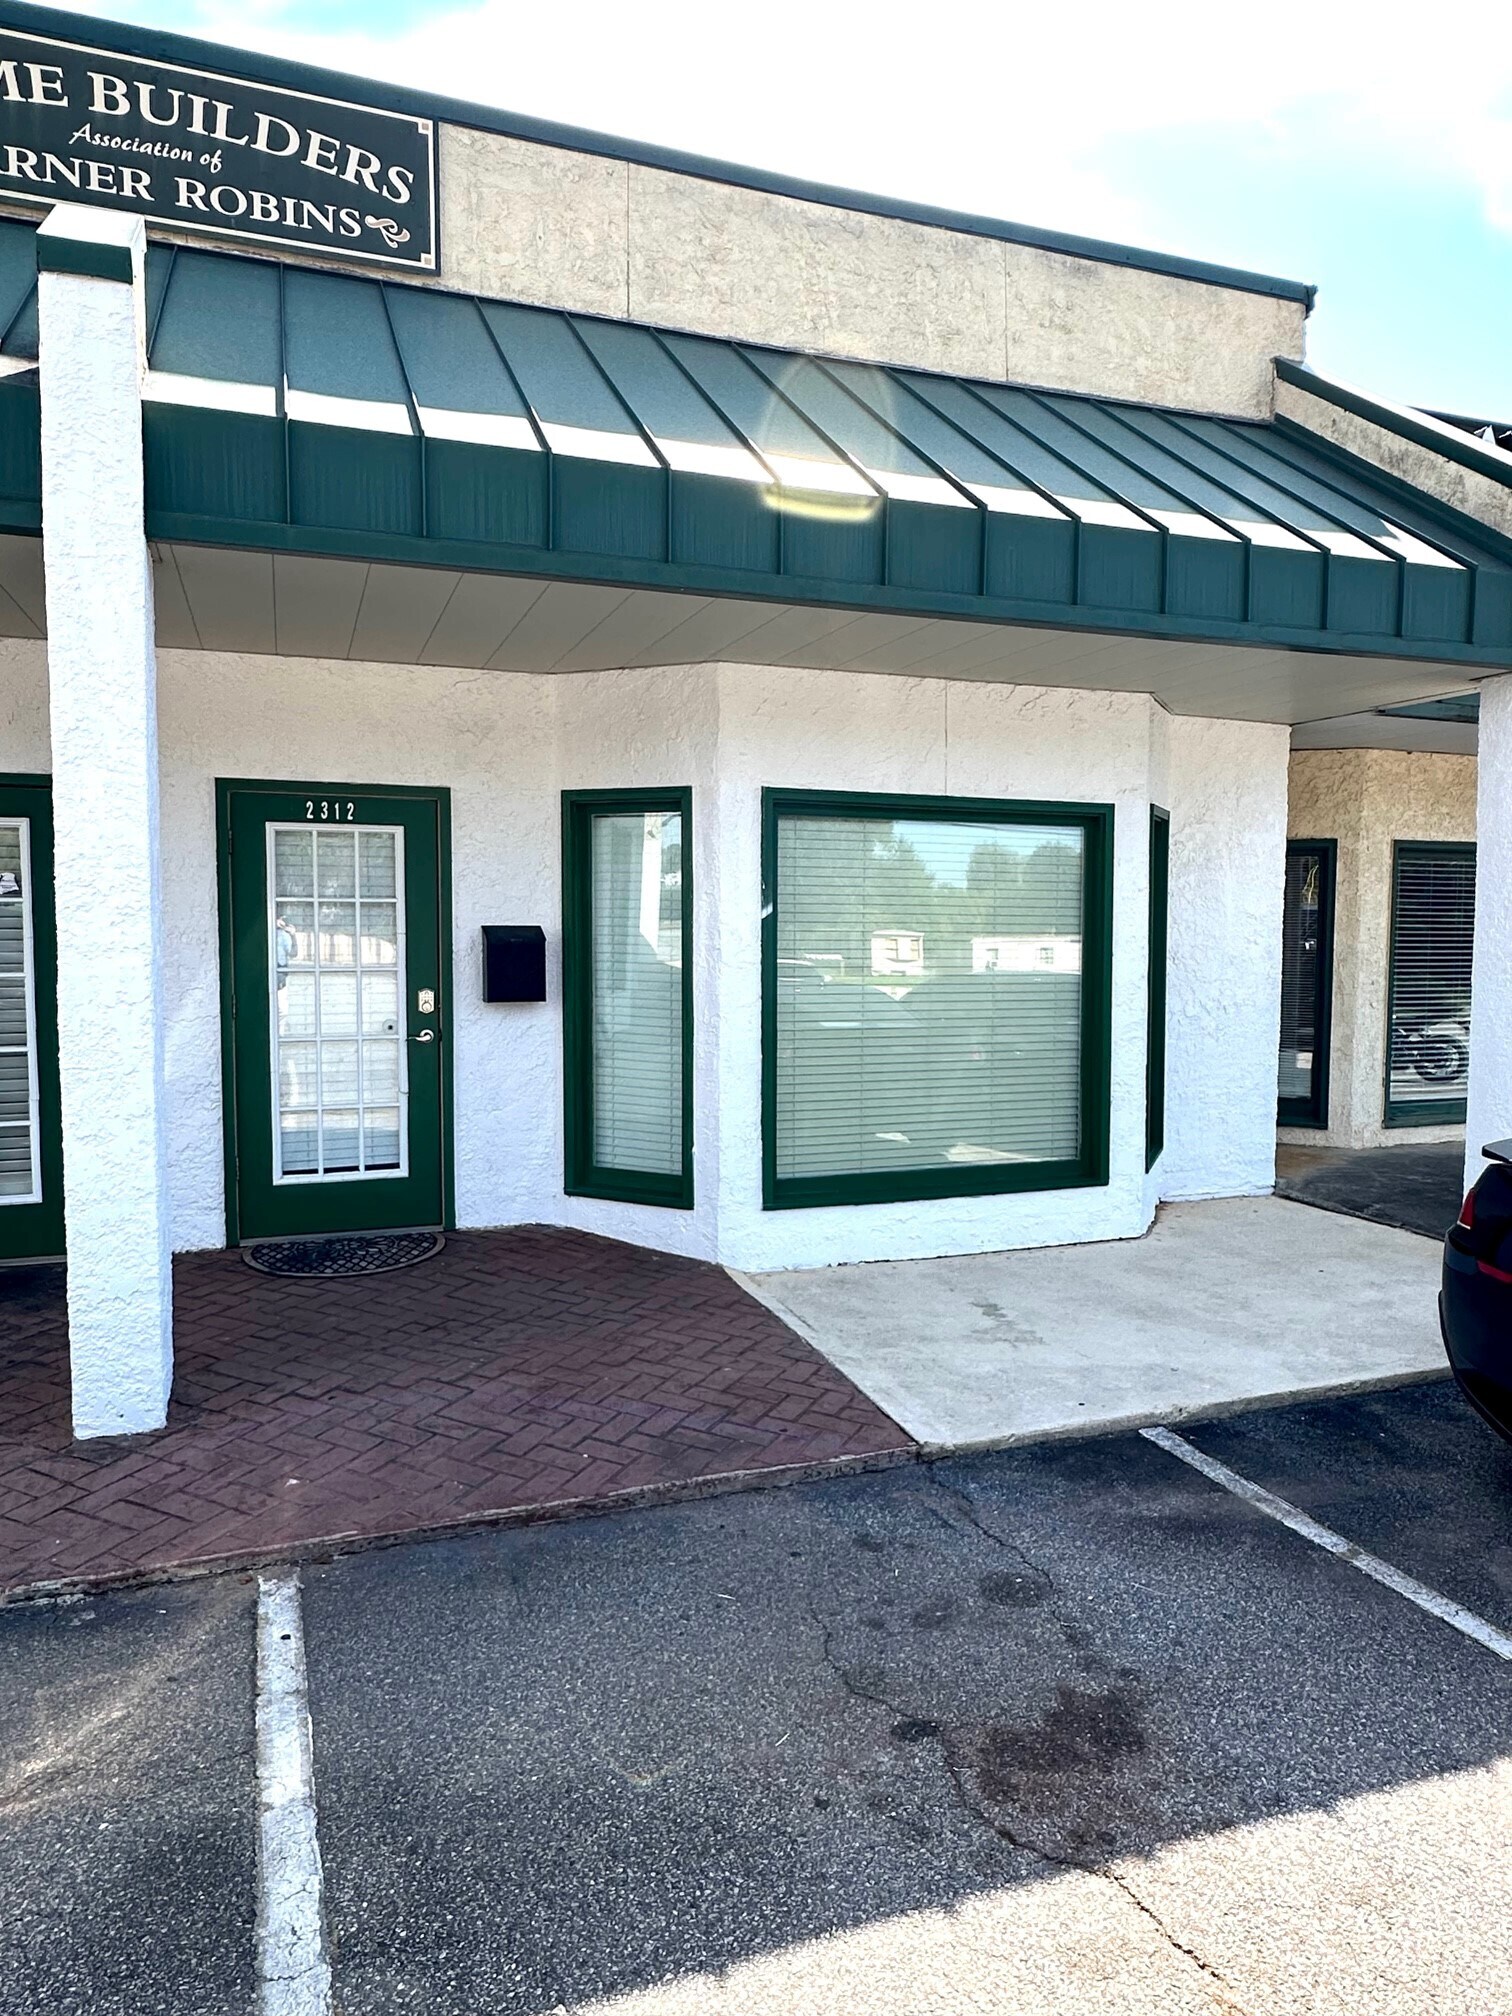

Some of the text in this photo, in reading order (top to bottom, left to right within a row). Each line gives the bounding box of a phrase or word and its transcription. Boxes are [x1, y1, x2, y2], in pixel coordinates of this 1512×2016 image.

[69, 122, 222, 174] Association of
[87, 71, 414, 204] BUILDERS
[0, 145, 362, 238] RNER ROBINS
[306, 800, 354, 820] 2312
